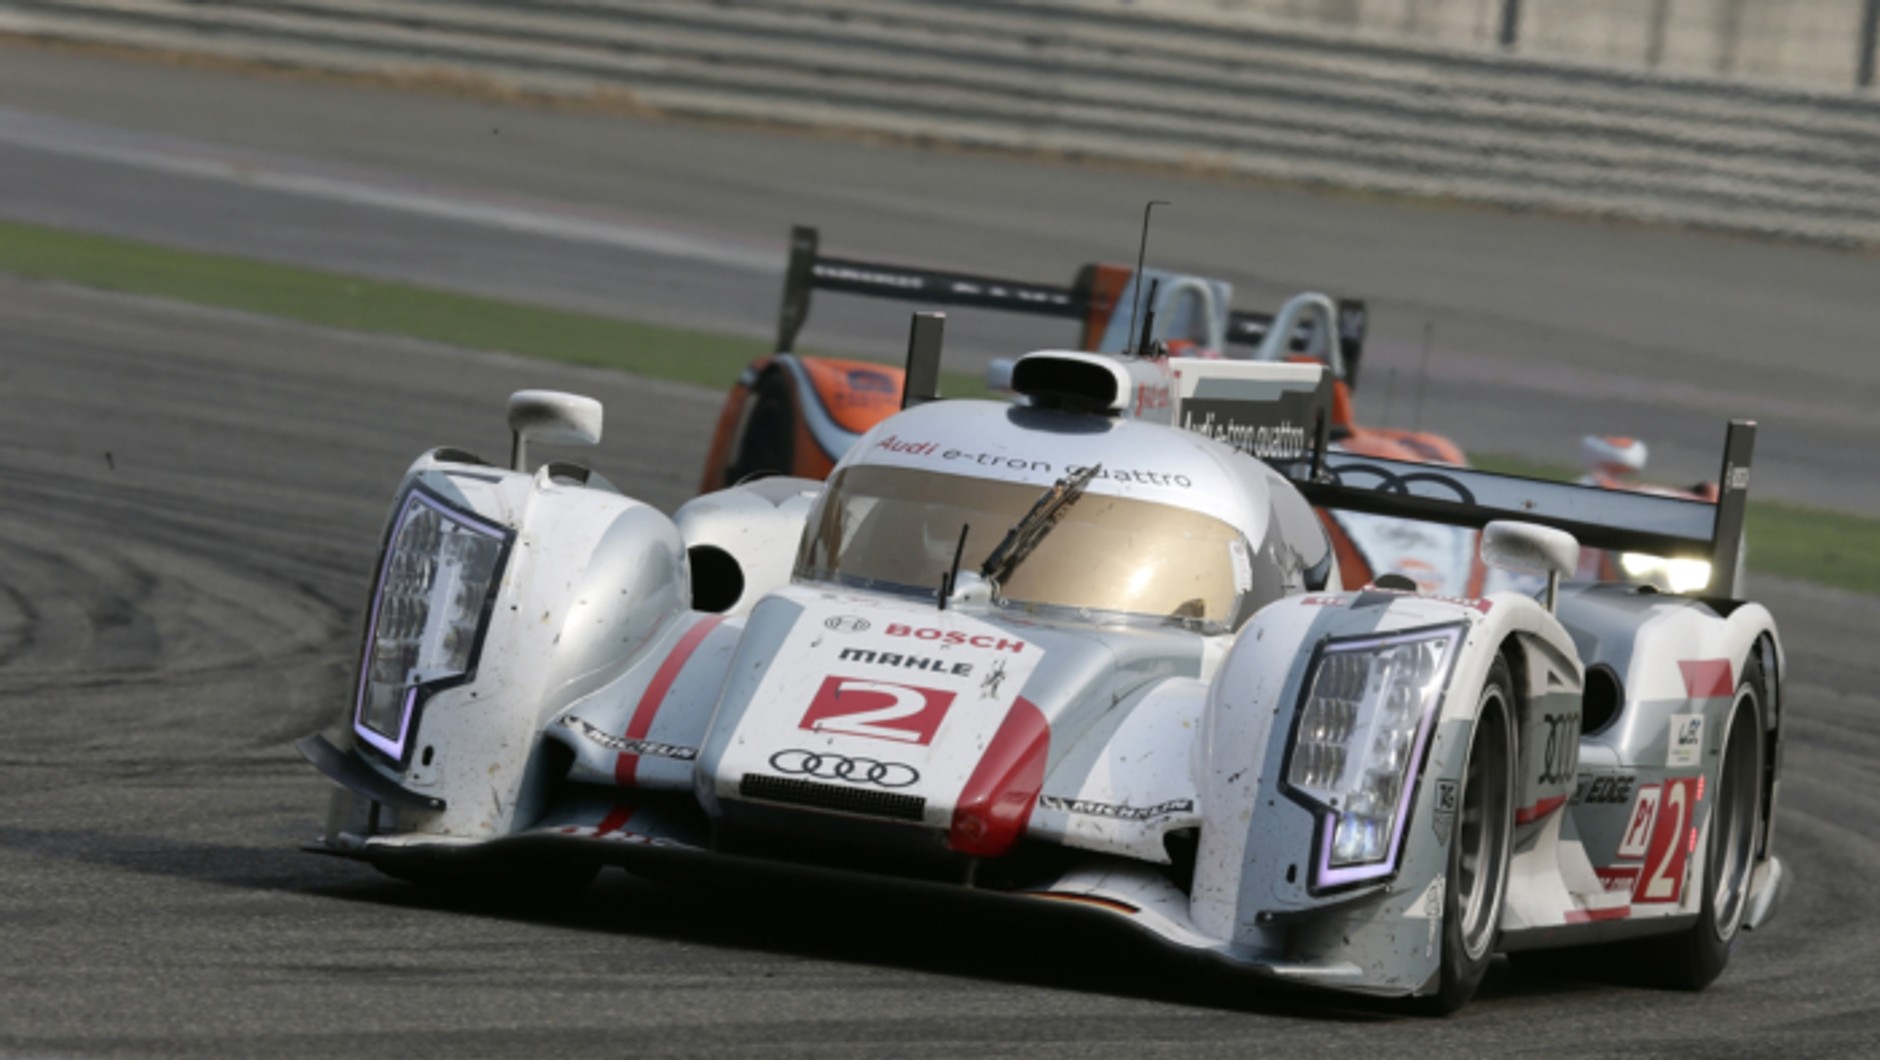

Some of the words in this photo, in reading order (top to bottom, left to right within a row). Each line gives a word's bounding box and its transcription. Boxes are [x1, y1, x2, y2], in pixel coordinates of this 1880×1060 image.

[875, 434, 941, 457] Audi
[942, 448, 1052, 473] e-tron
[884, 623, 1025, 654] BOSCH
[837, 647, 974, 677] MAHLE
[810, 680, 927, 742] 2
[1584, 776, 1636, 804] EDGE
[1071, 800, 1188, 818] MICHELIN
[1626, 797, 1660, 847] P1
[1644, 780, 1686, 898] 2
